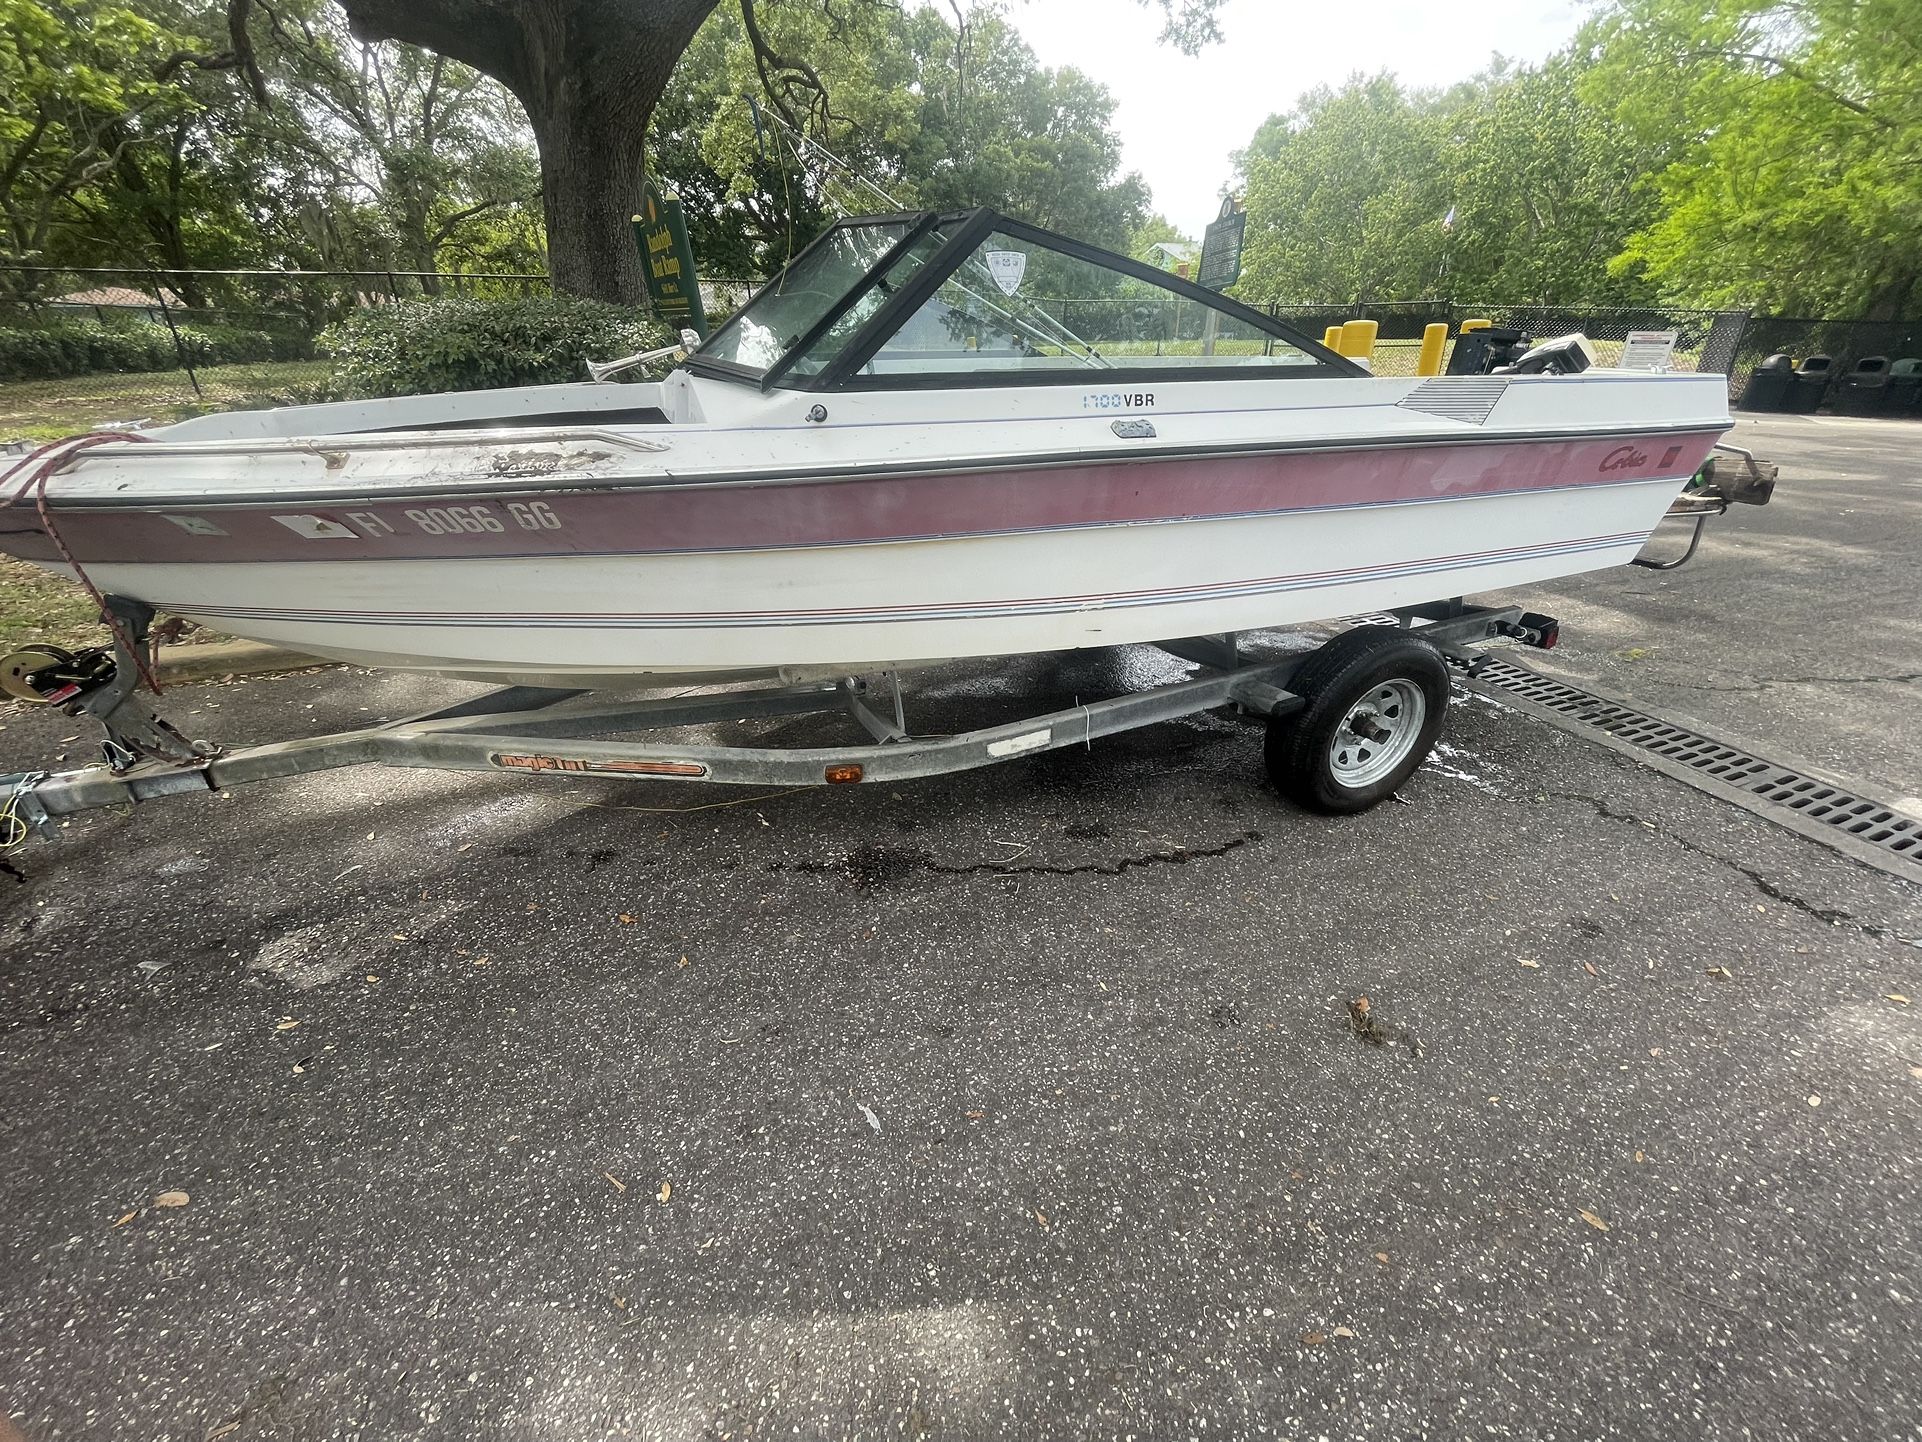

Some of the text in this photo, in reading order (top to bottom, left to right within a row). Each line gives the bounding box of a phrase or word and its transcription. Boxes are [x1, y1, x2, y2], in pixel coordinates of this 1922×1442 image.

[661, 255, 680, 279] Ramp
[404, 506, 504, 534] 8066
[507, 501, 562, 530] GG
